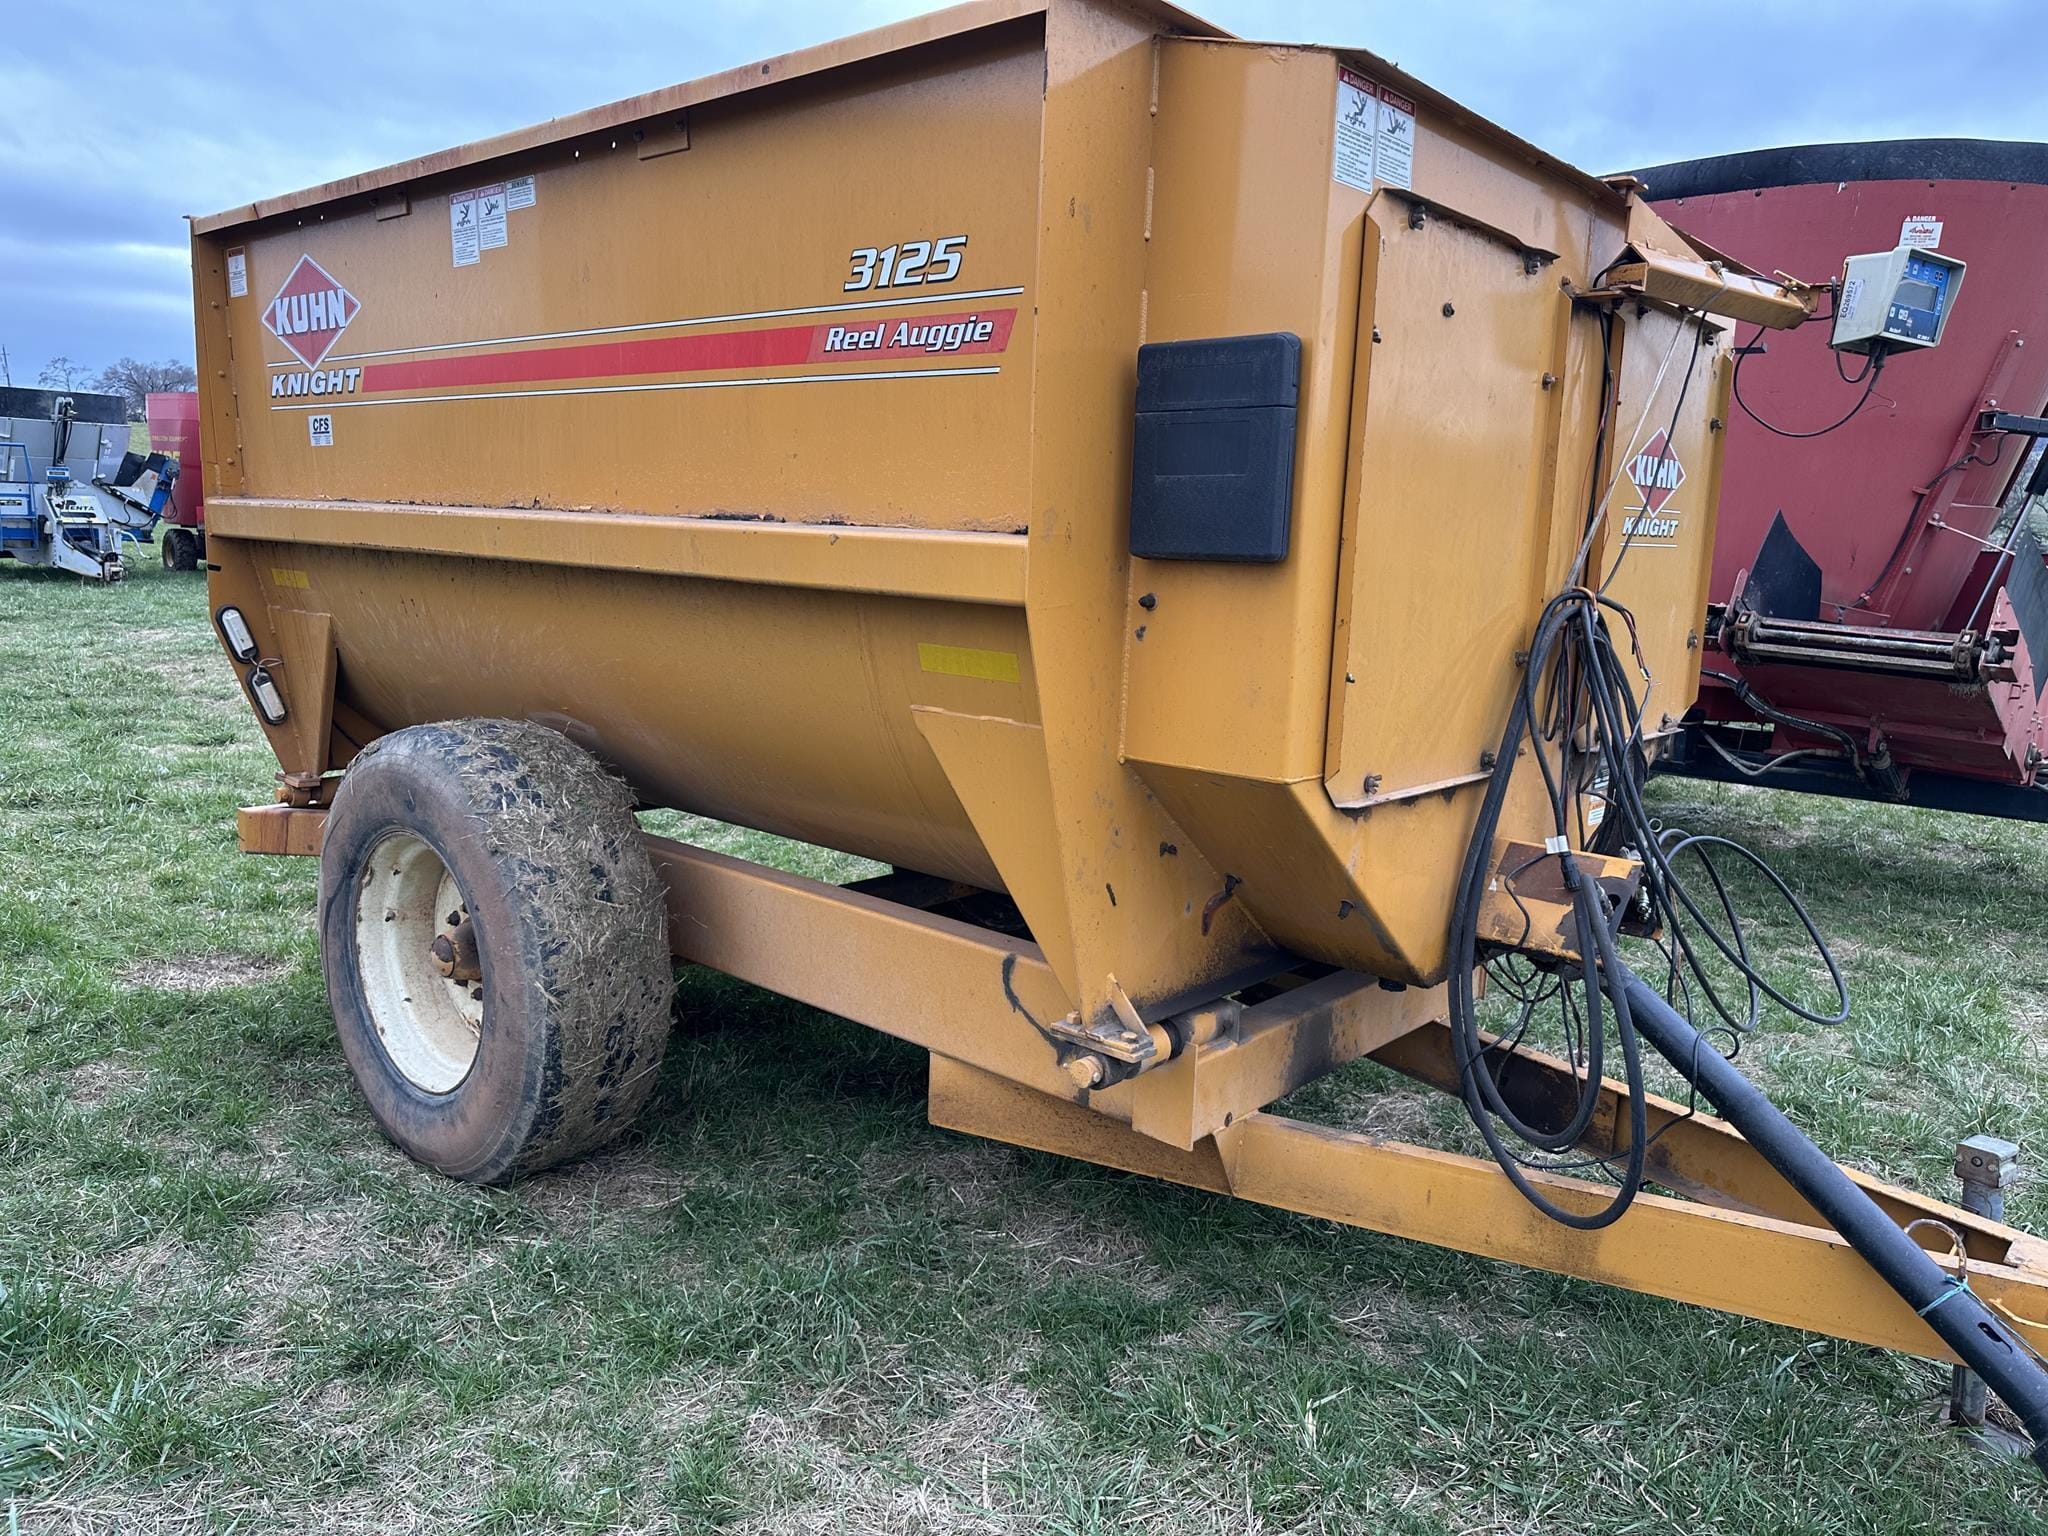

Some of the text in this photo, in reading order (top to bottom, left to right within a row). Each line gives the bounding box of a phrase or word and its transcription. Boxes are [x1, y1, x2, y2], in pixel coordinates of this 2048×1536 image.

[1349, 74, 1374, 95] DANGER
[1389, 92, 1413, 111] DANGER
[844, 235, 968, 292] 3125
[274, 288, 347, 336] KUHN
[1840, 281, 1857, 318] EQ269572
[824, 315, 994, 353] Reel Auggie
[271, 367, 361, 398] KNIGHT
[312, 417, 330, 432] CFS
[1634, 454, 1680, 490] KUHN
[1622, 516, 1679, 538] KNIGHT
